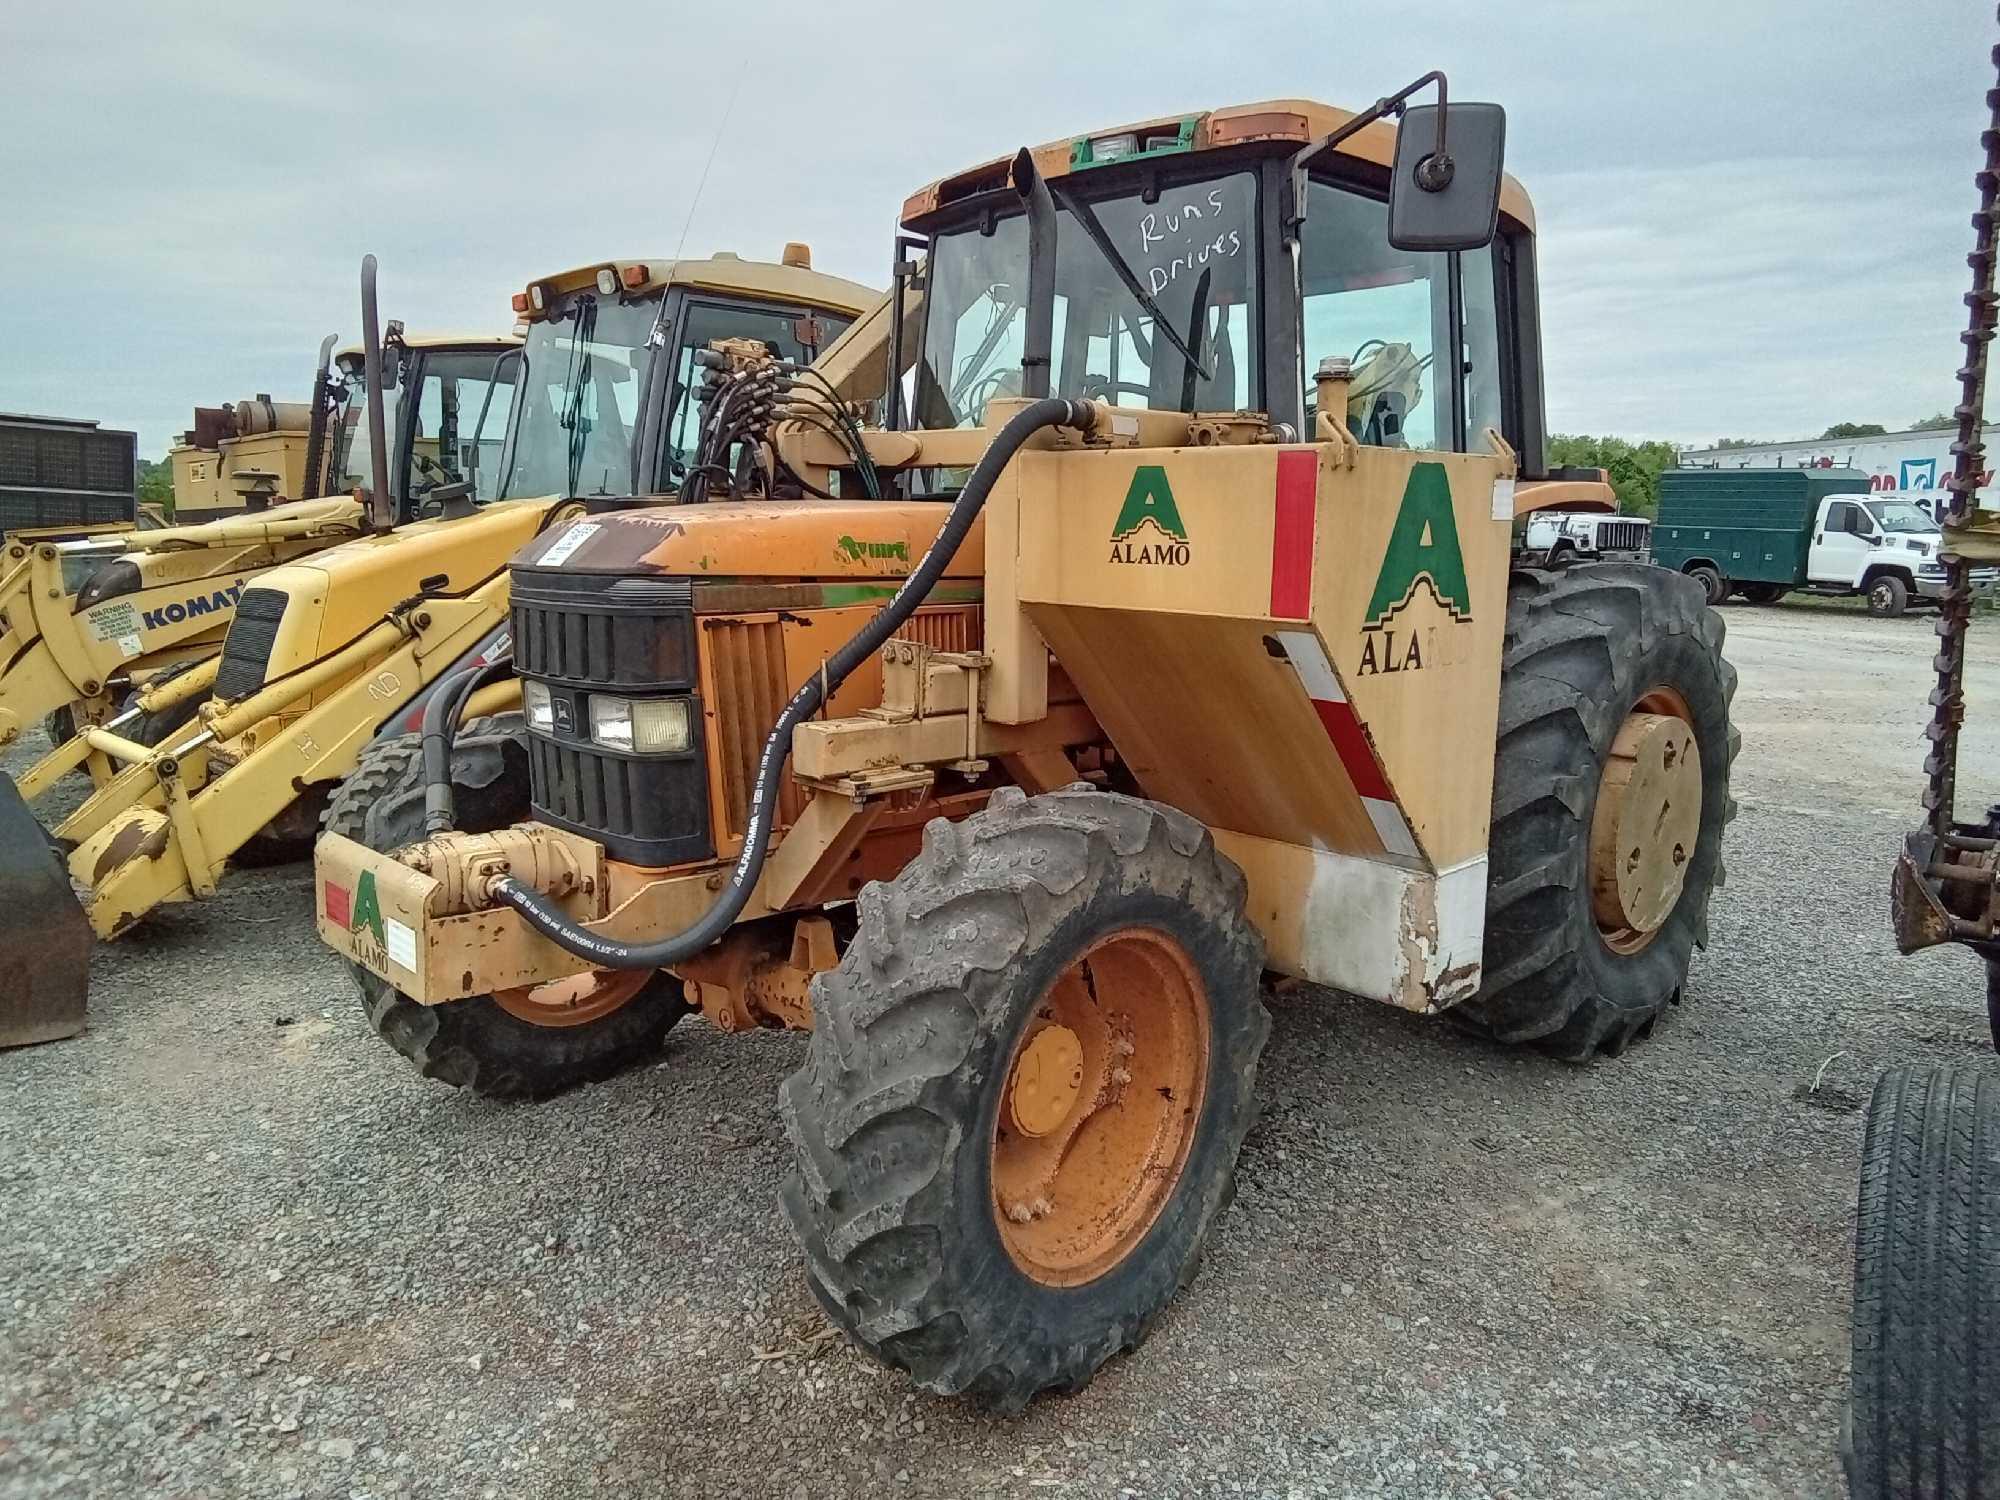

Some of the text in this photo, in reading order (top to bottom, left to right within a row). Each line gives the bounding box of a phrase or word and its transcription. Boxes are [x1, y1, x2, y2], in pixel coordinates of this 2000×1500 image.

[1140, 189, 1223, 254] Runs
[1149, 230, 1241, 296] Drives
[1108, 543, 1190, 567] ALAMO
[738, 815, 760, 878] ALFAGOMMA
[351, 938, 389, 975] ALAMO
